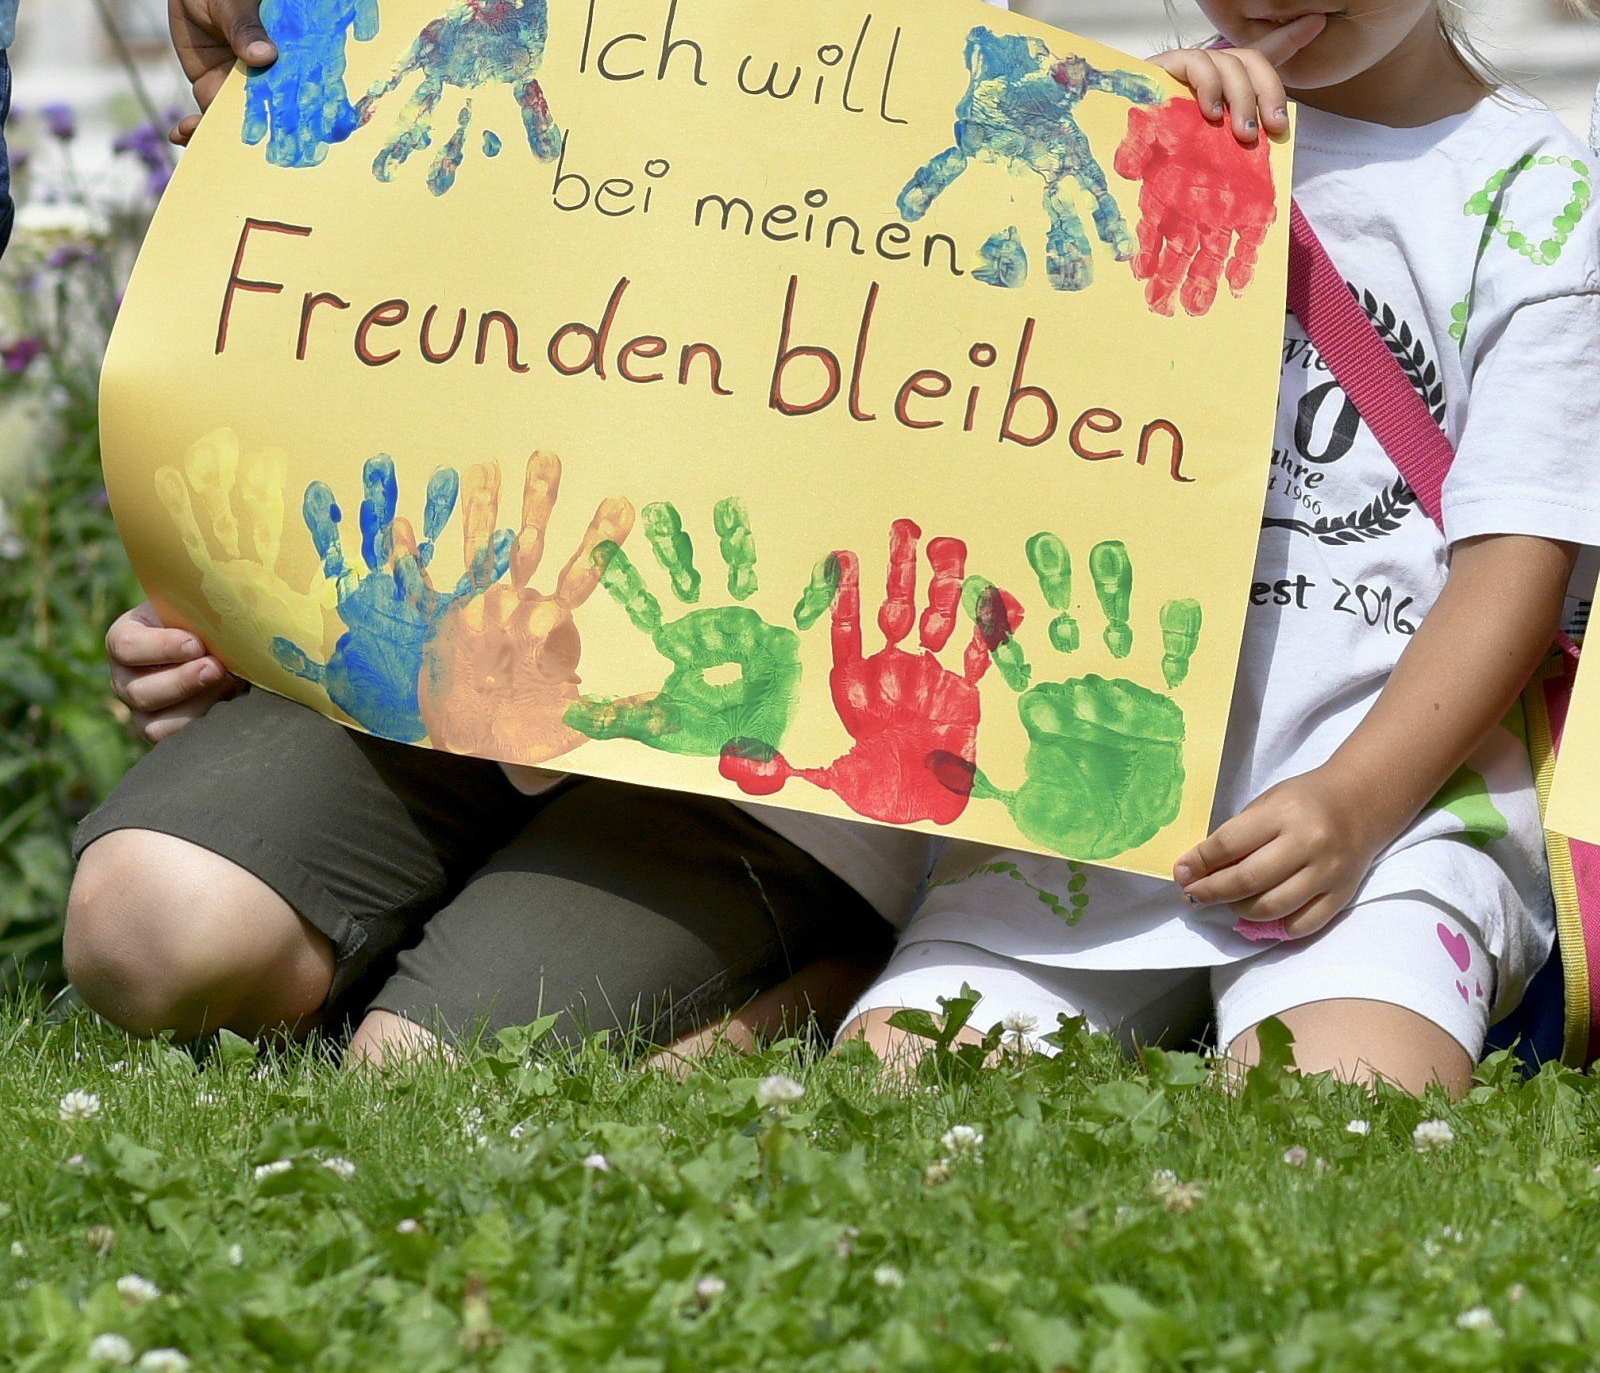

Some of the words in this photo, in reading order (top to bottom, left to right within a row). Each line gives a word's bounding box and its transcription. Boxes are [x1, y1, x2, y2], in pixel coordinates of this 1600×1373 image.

[737, 13, 909, 125] will
[552, 128, 671, 217] bei
[694, 188, 965, 276] meinen
[214, 216, 734, 396] Freunden
[768, 274, 1197, 483] bleiben
[1293, 380, 1362, 465] 0
[1282, 478, 1323, 516] 1966
[1249, 573, 1316, 610] est
[1331, 576, 1417, 636] 2016
